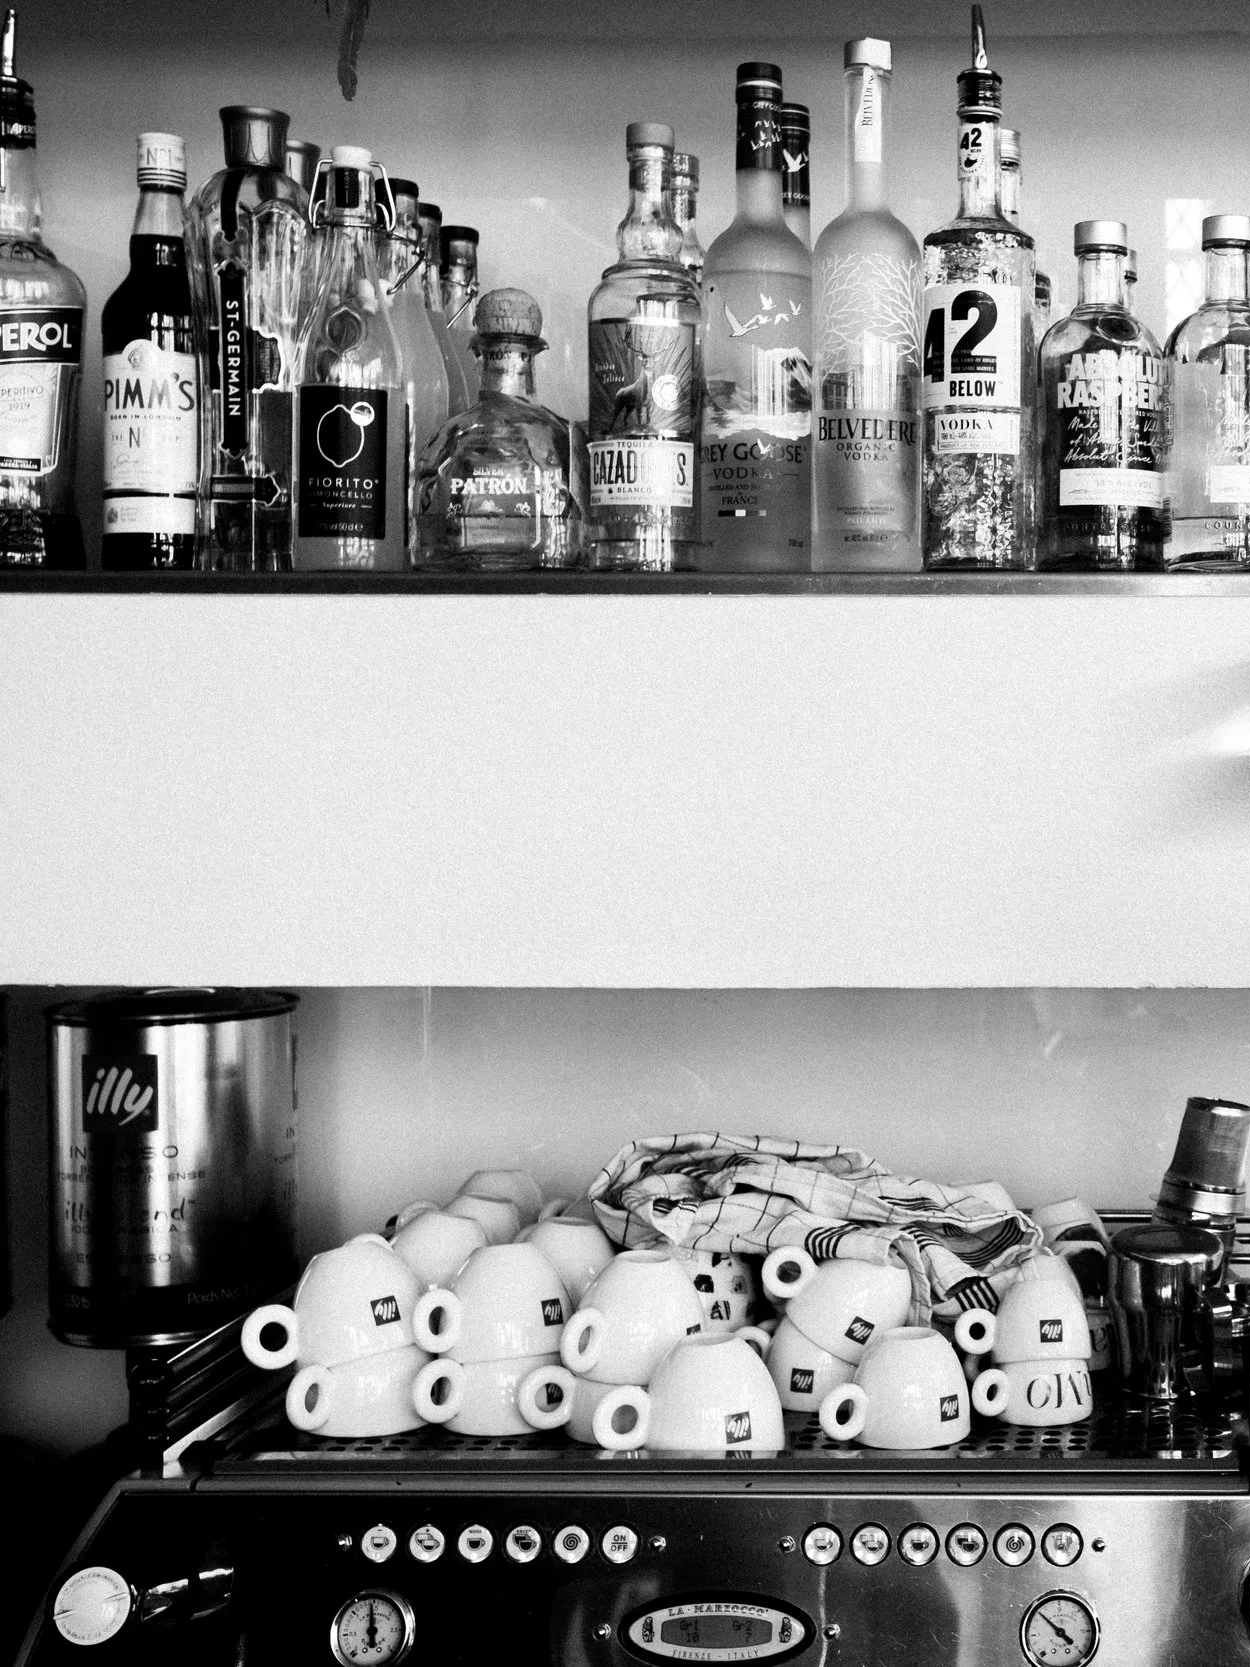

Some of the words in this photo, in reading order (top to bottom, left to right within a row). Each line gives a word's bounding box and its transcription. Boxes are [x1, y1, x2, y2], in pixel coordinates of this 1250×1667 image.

[960, 127, 982, 150] 42
[0, 322, 72, 352] EROL
[923, 290, 998, 383] 42
[226, 301, 241, 416] ST-GERMAIN
[949, 380, 996, 397] BELOW
[819, 416, 917, 446] BELVEDERE
[593, 450, 687, 487] CAZADS
[308, 476, 373, 490] FIORITO
[309, 490, 373, 500] MONCELLO
[450, 473, 528, 495] PATRÓN
[86, 1066, 154, 1127] illy
[672, 1649, 712, 1661] FIRENZE
[727, 1649, 760, 1660] ITALY
